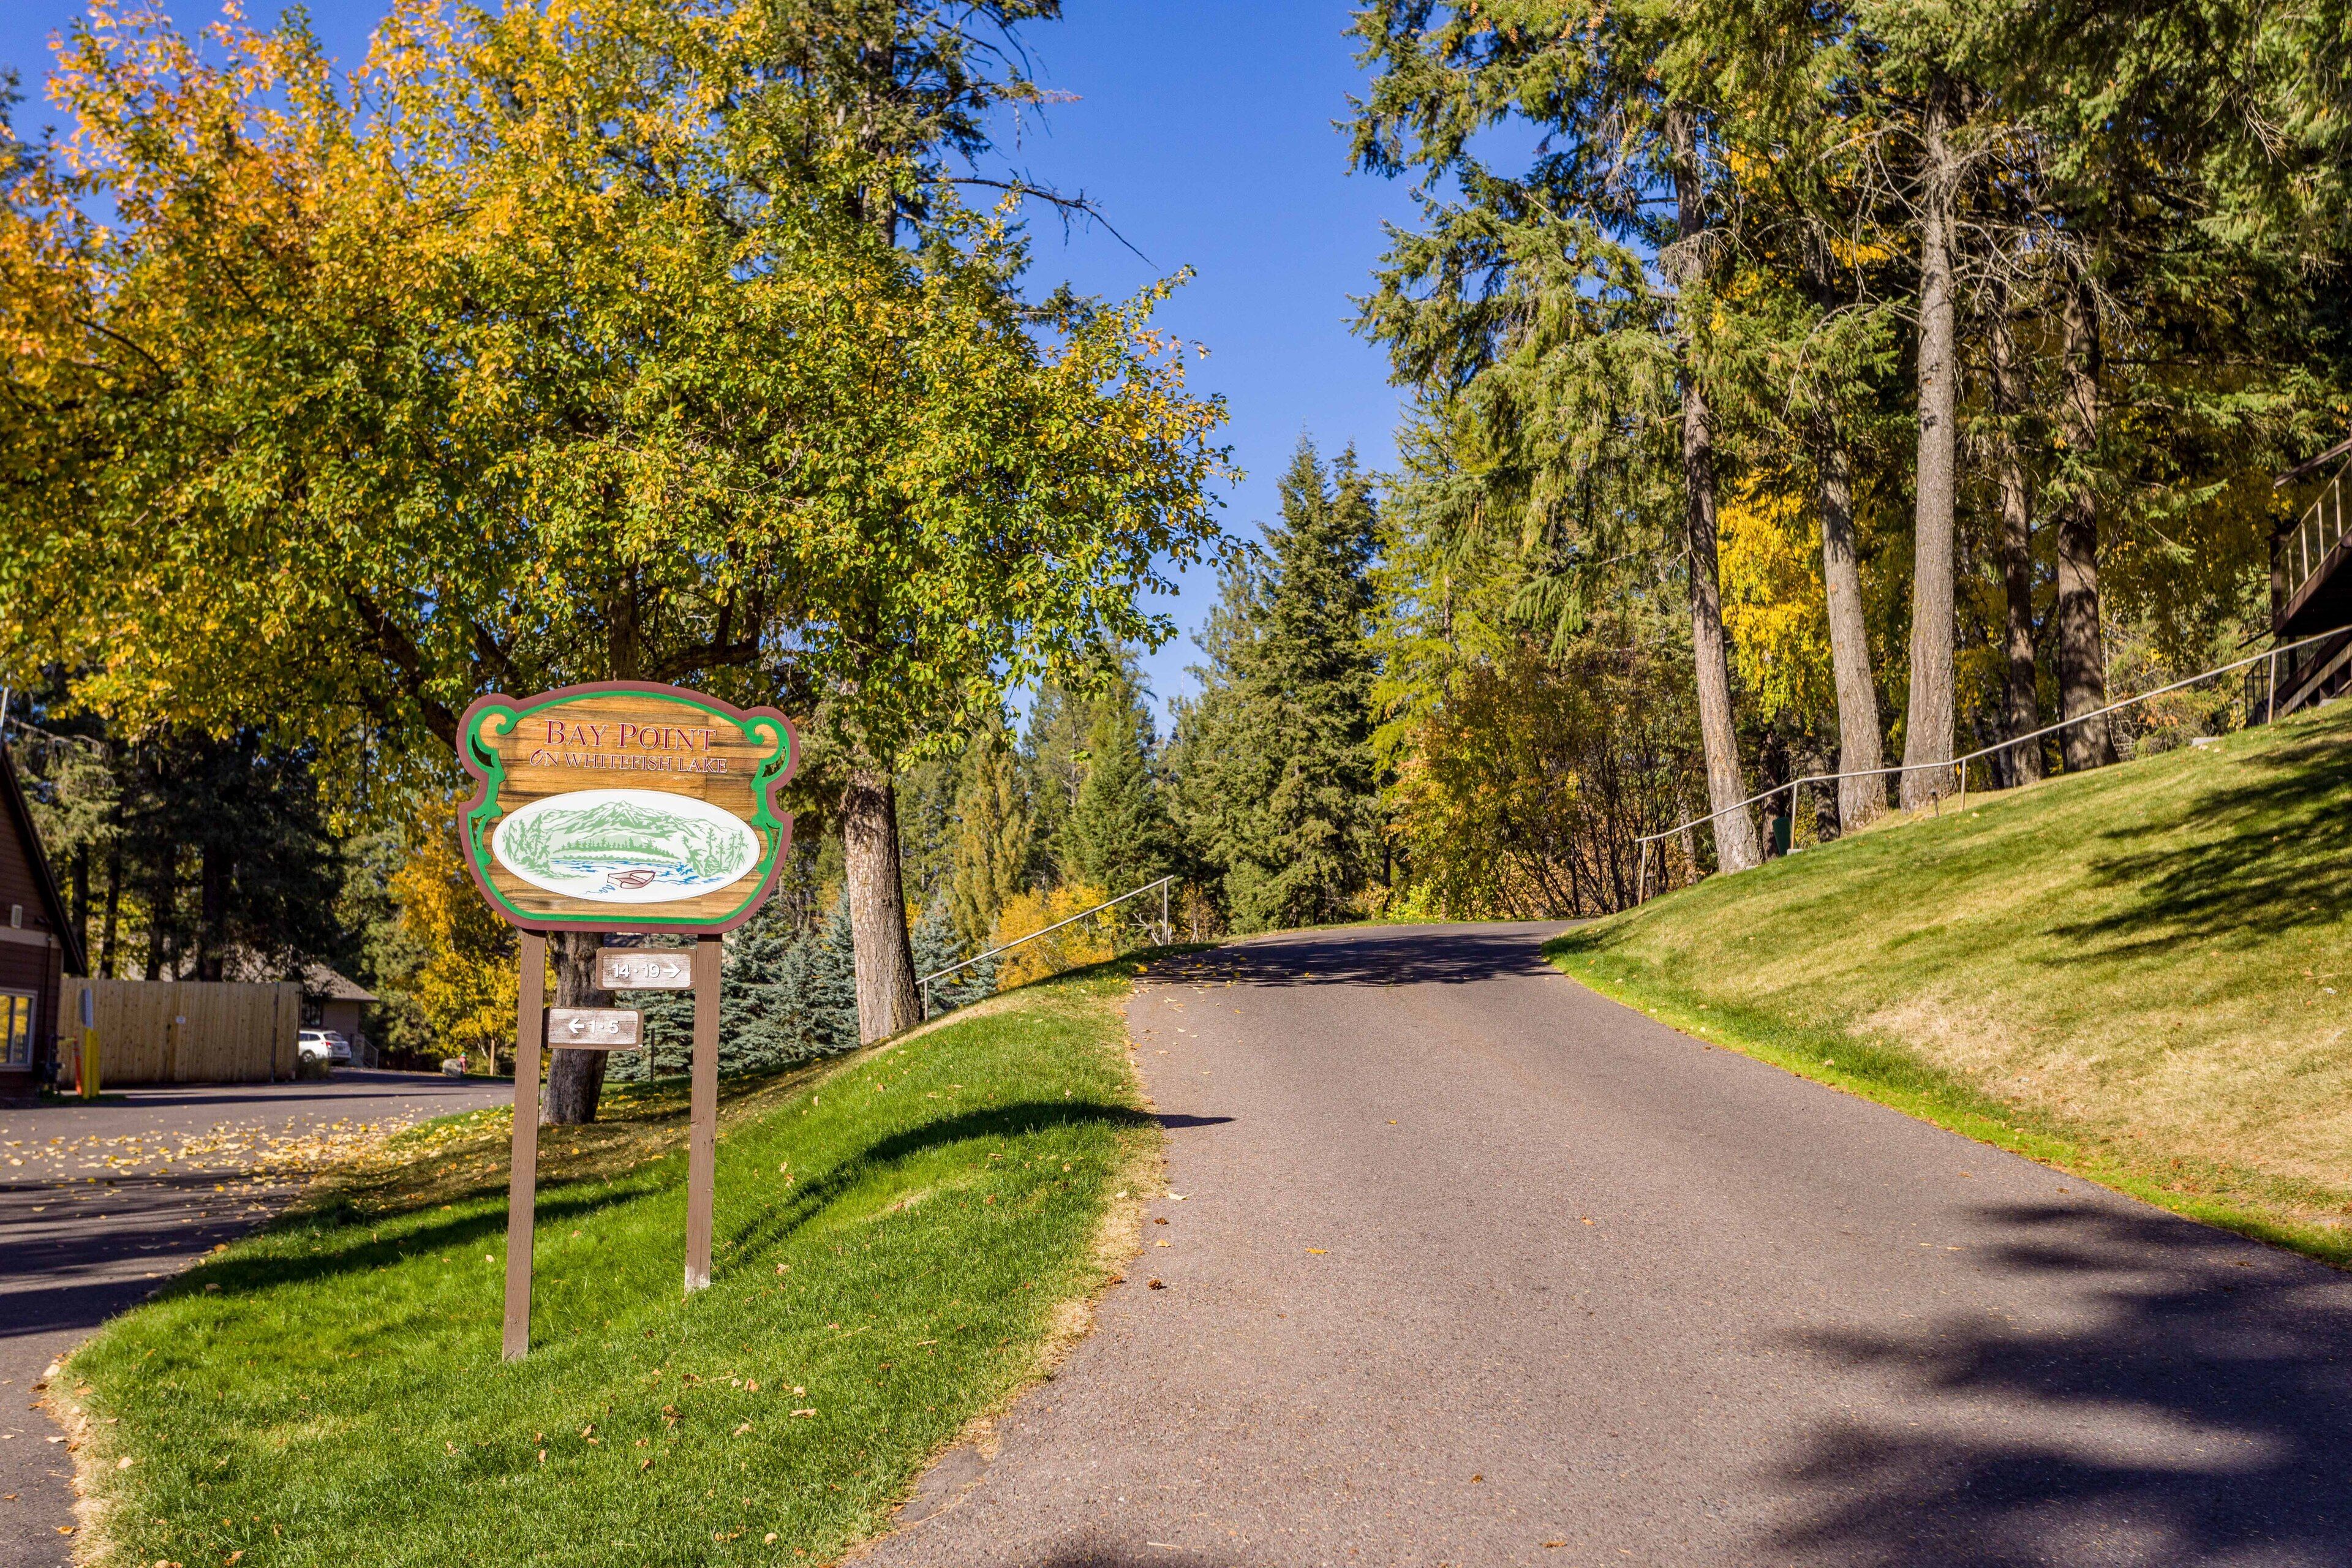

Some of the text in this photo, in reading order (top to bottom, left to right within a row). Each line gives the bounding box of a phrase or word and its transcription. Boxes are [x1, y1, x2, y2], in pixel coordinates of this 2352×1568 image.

[544, 719, 717, 751] BAY POINT
[530, 748, 728, 774] ON WHITEFISH LAKE
